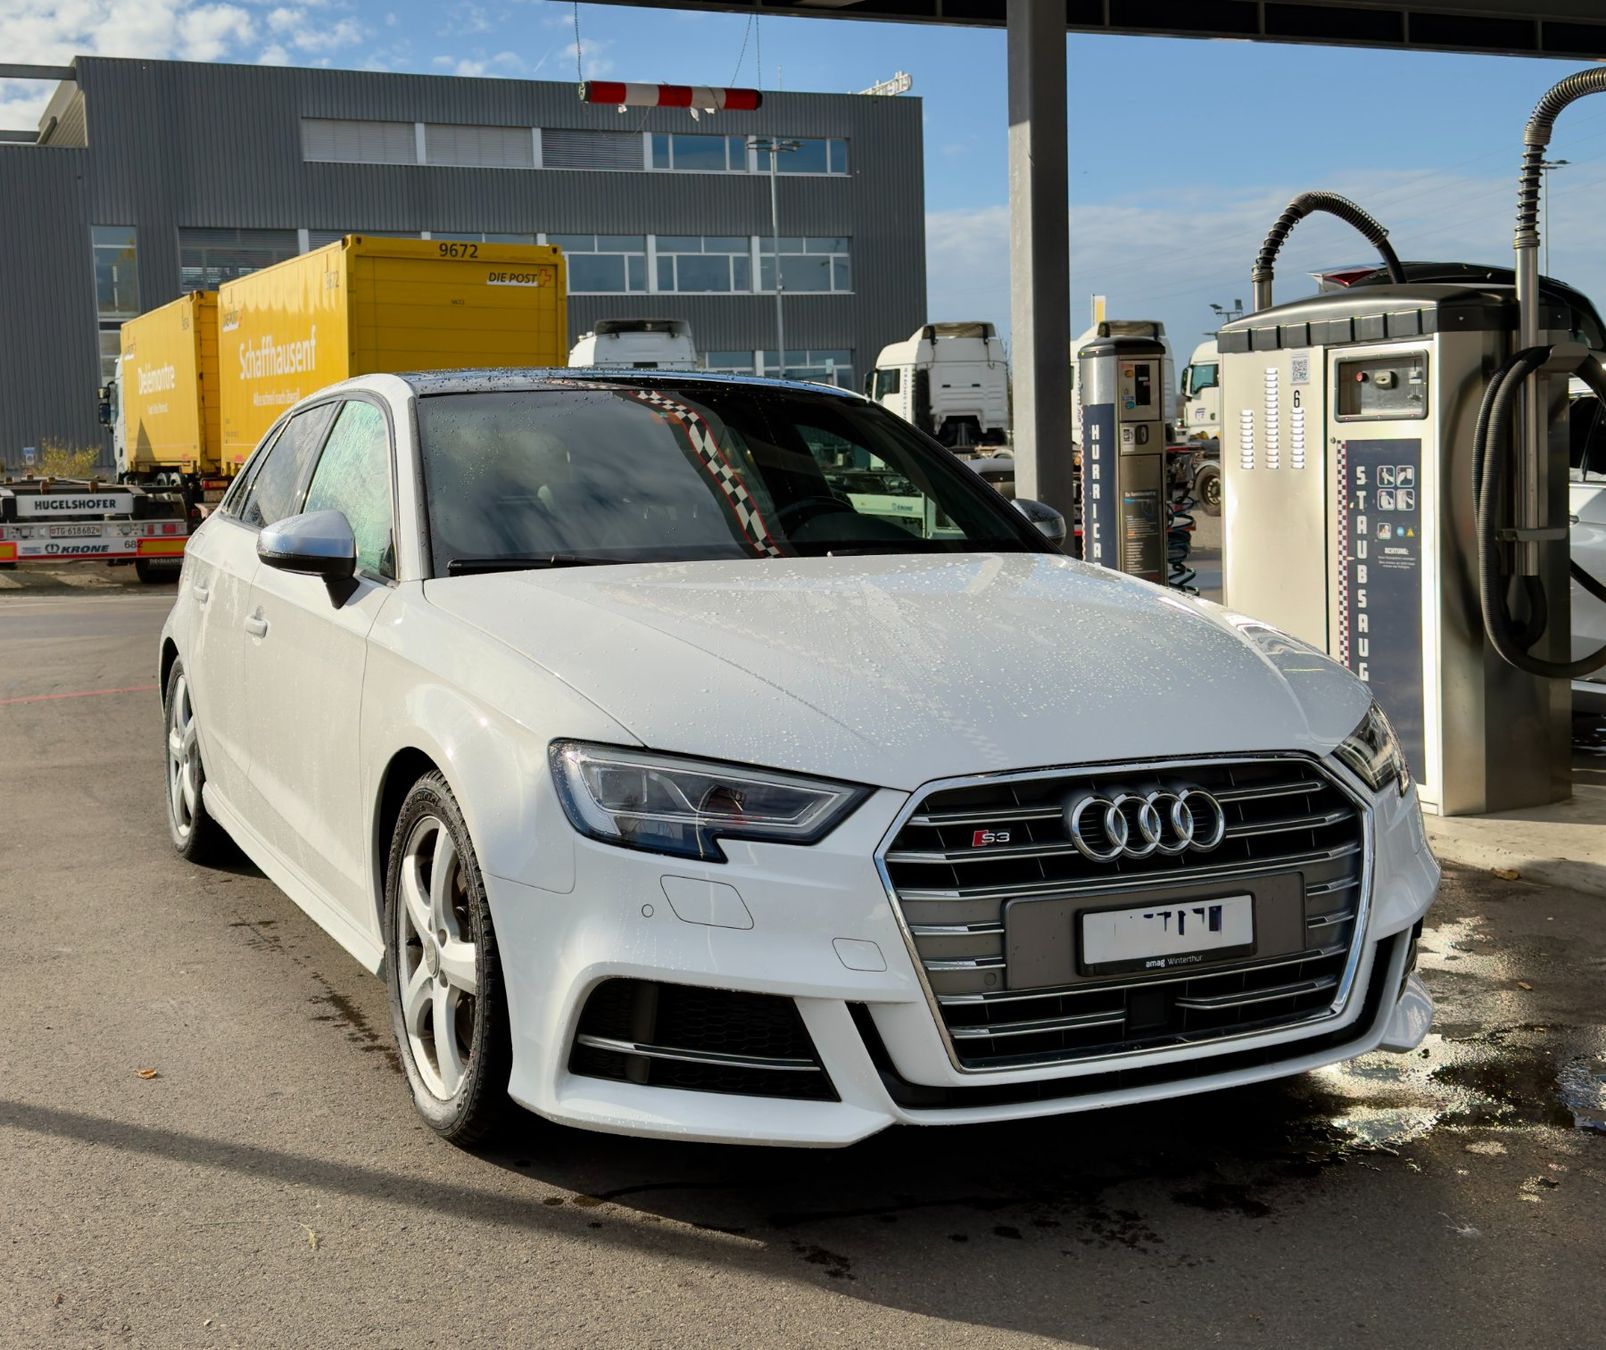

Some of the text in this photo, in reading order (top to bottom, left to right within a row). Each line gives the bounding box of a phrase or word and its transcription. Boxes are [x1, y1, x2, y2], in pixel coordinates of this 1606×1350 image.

[439, 243, 479, 258] 9672
[488, 272, 538, 284] DIE POST
[1293, 389, 1301, 408] 6
[1091, 424, 1102, 567] HURRICA
[34, 499, 116, 511] HUGELSHOFER
[60, 545, 109, 554] KRONE
[124, 540, 143, 549] 682
[979, 831, 1010, 844] S3
[1145, 955, 1203, 968] amag Winterthur
